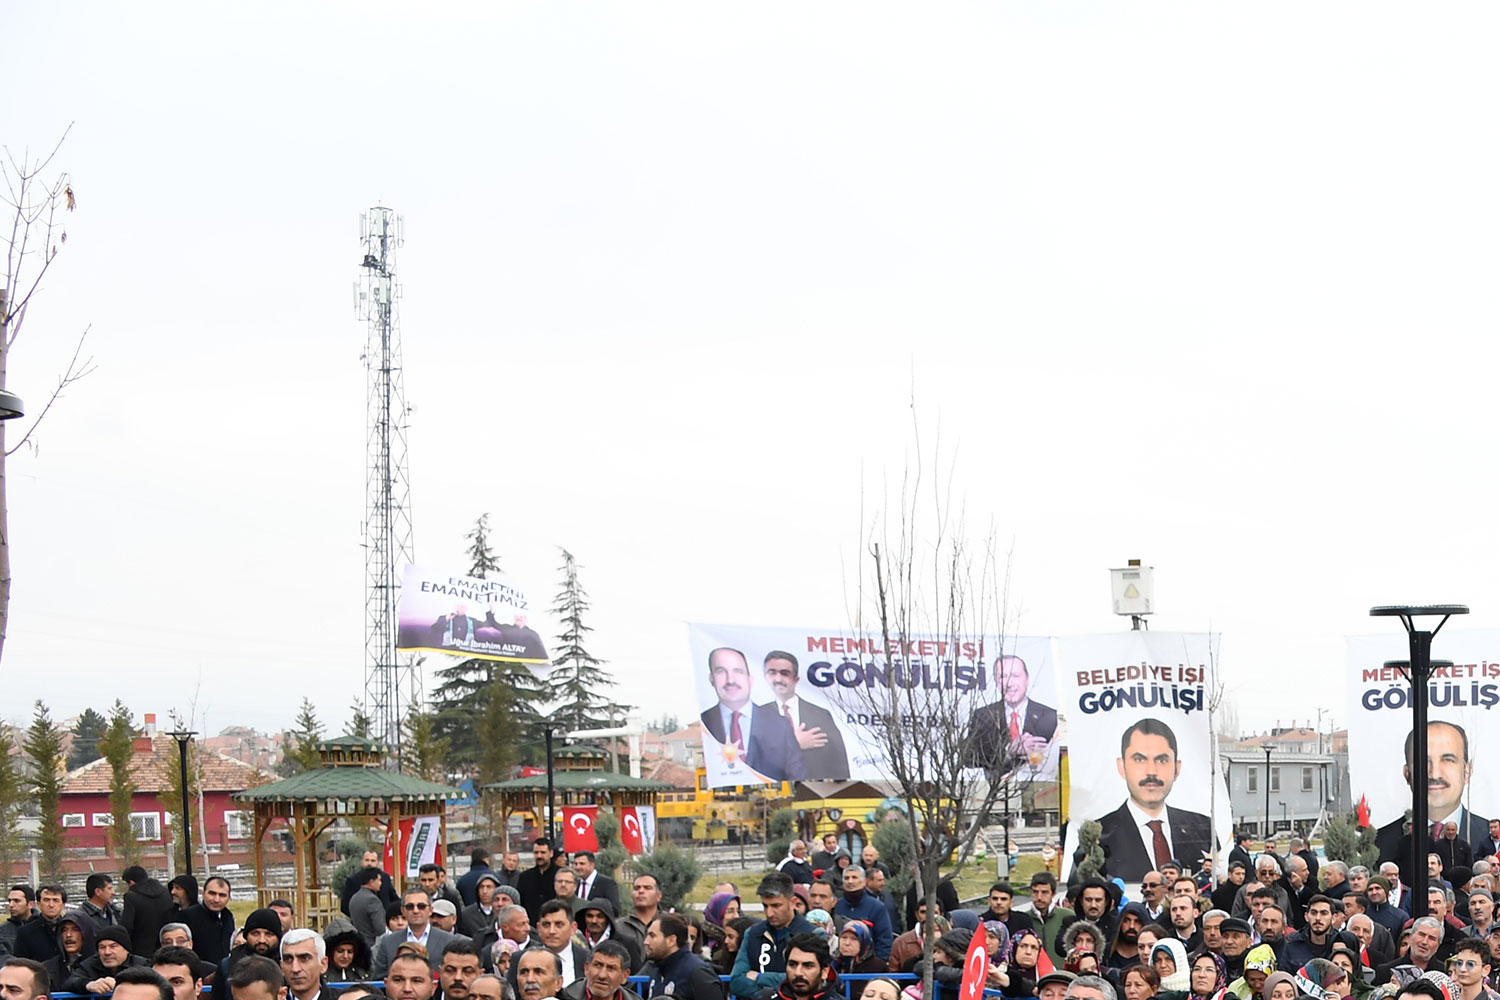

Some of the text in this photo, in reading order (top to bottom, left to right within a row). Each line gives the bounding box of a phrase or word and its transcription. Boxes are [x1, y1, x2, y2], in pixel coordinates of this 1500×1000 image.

[421, 581, 528, 610] EMANETİMİZ
[502, 643, 527, 653] ALTAY
[807, 636, 985, 660] MEMLEKET İŞİ
[807, 657, 987, 695] GÖNÜL İŞİ
[1077, 662, 1205, 686] BELEDİYE İŞİ
[1362, 664, 1477, 682] MEMKET
[1079, 682, 1203, 715] GÖNÜL İŞİ
[846, 713, 894, 727] ADE
